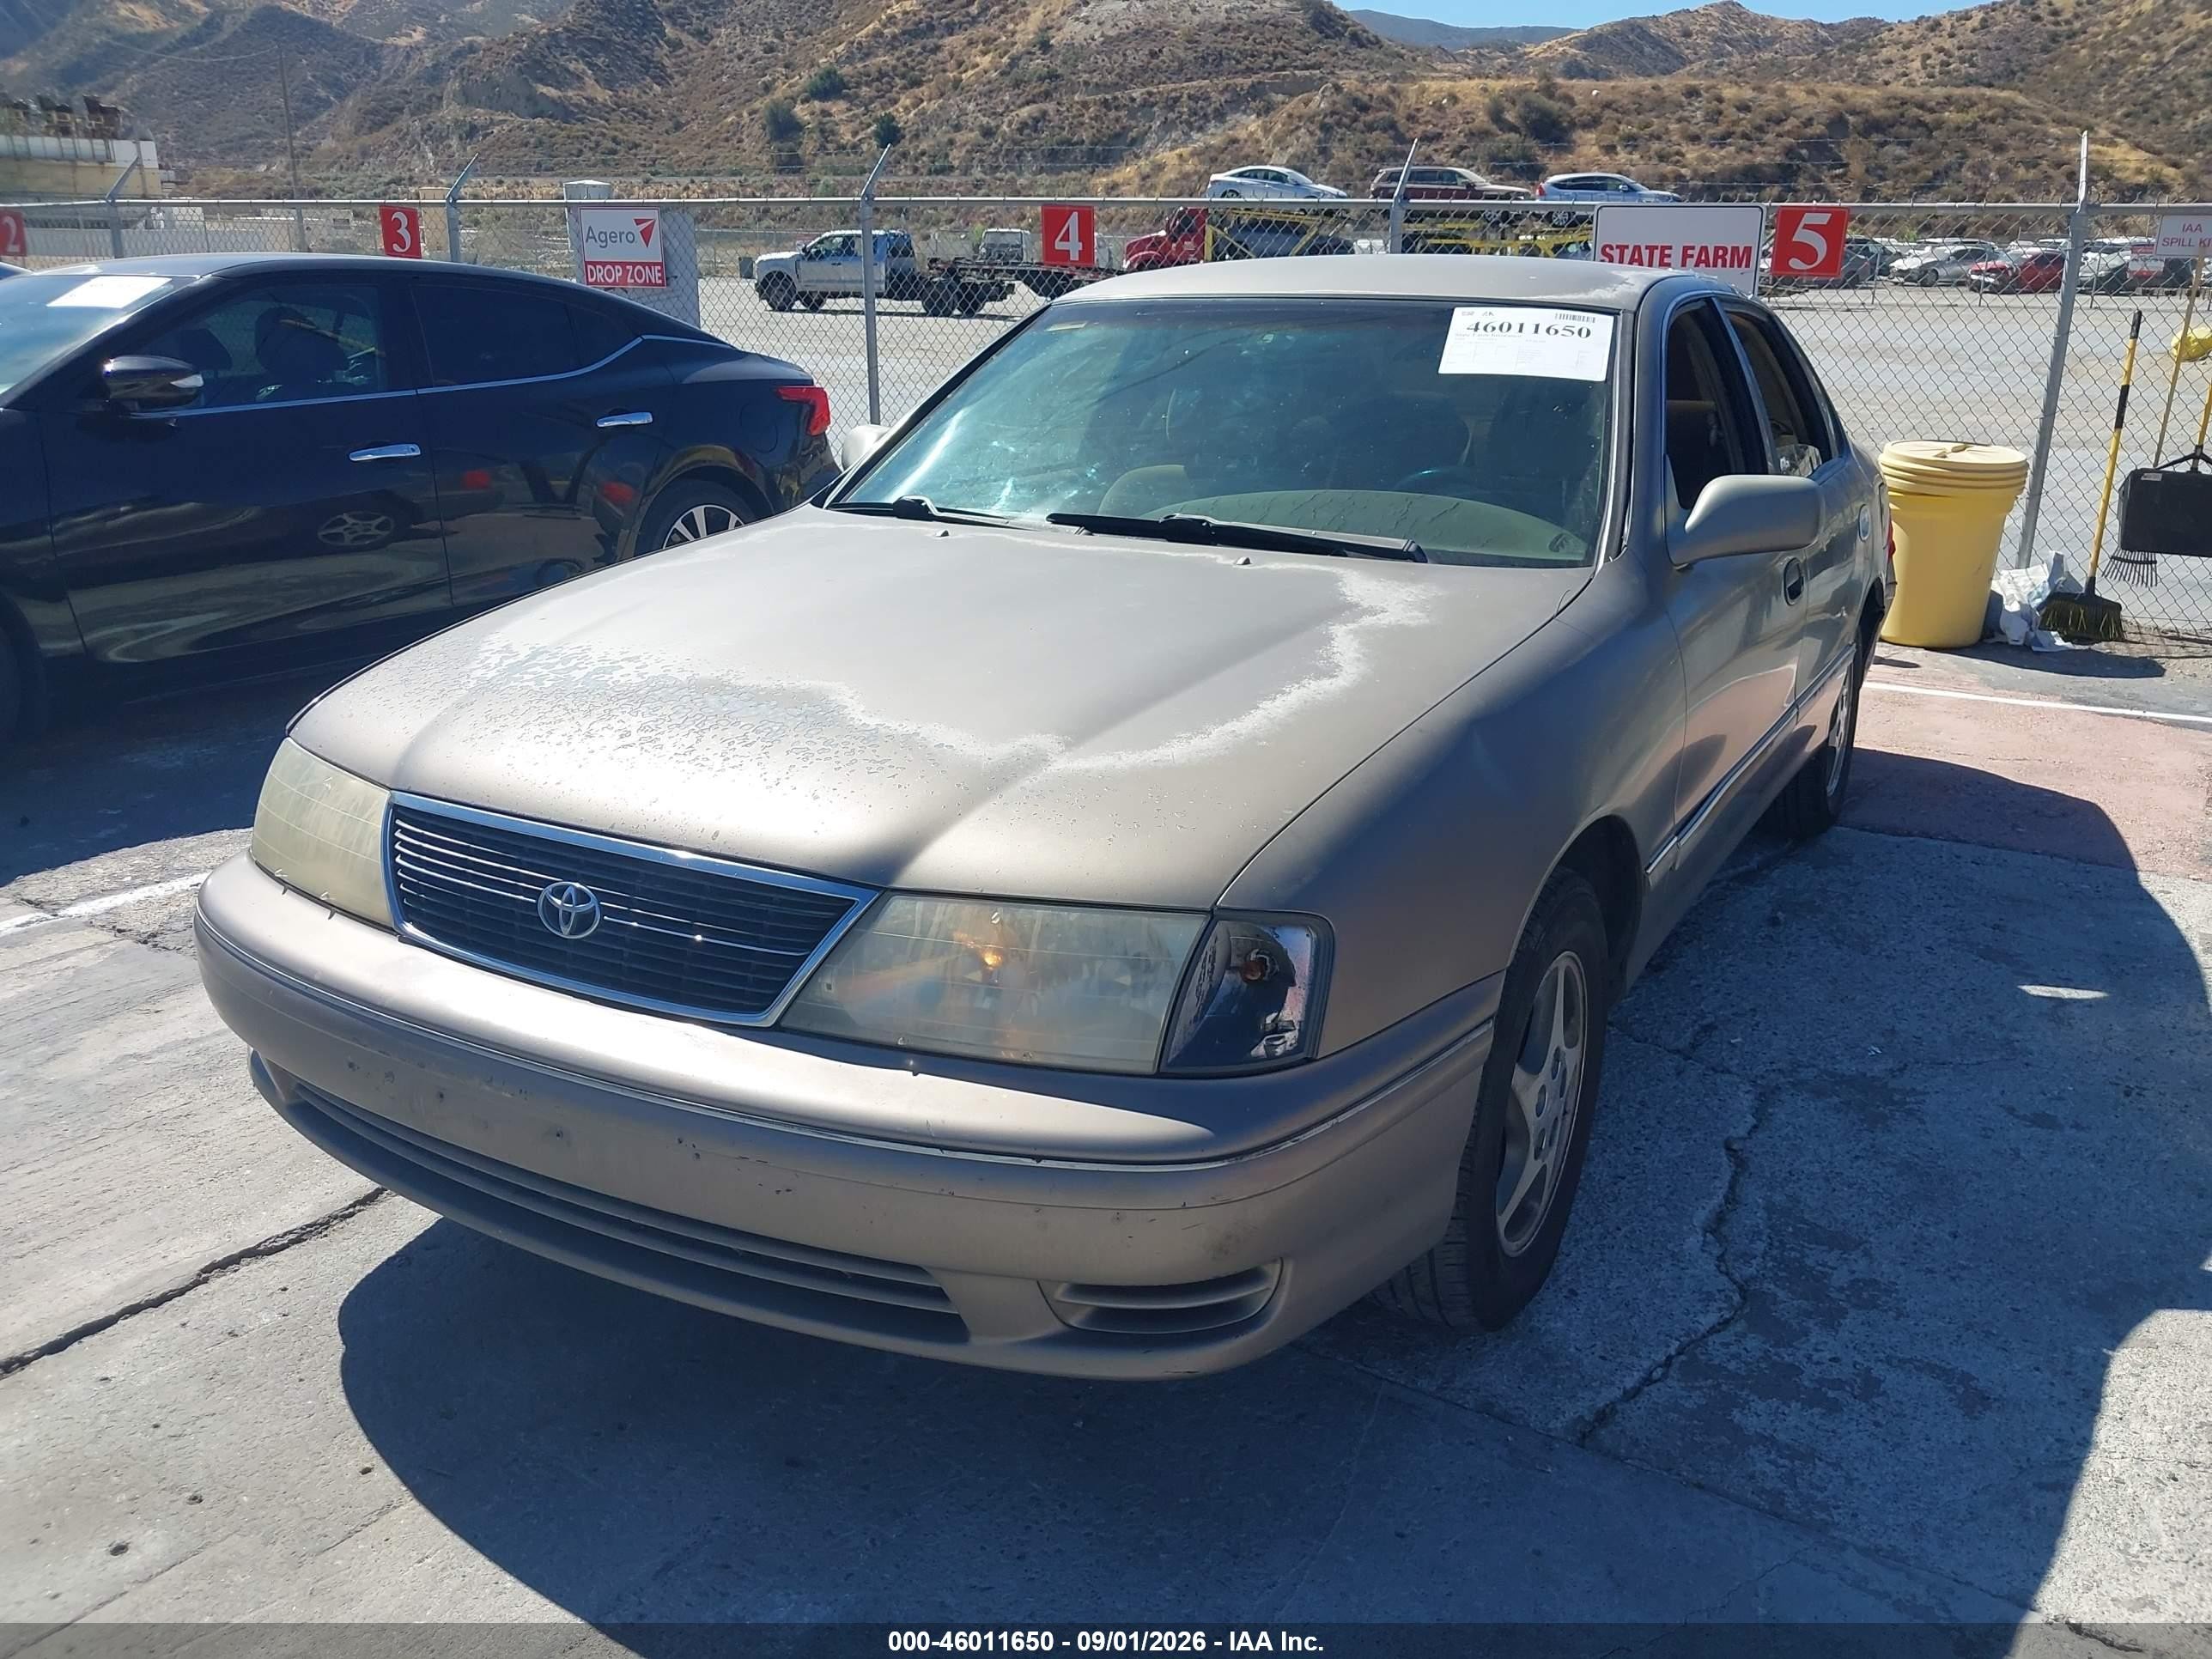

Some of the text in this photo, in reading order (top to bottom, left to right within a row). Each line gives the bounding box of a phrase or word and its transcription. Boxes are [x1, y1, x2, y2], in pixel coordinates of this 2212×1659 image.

[1, 216, 21, 252] 2
[391, 211, 411, 252] 3
[585, 224, 635, 249] Agero
[1054, 211, 1083, 261] 4
[2182, 222, 2203, 233] IAA
[1788, 212, 1832, 270] 5
[2161, 237, 2195, 247] SPILL
[1600, 243, 1753, 269] STATE FARM
[586, 264, 662, 284] DROP ZONE
[1466, 320, 1591, 339] 46011650
